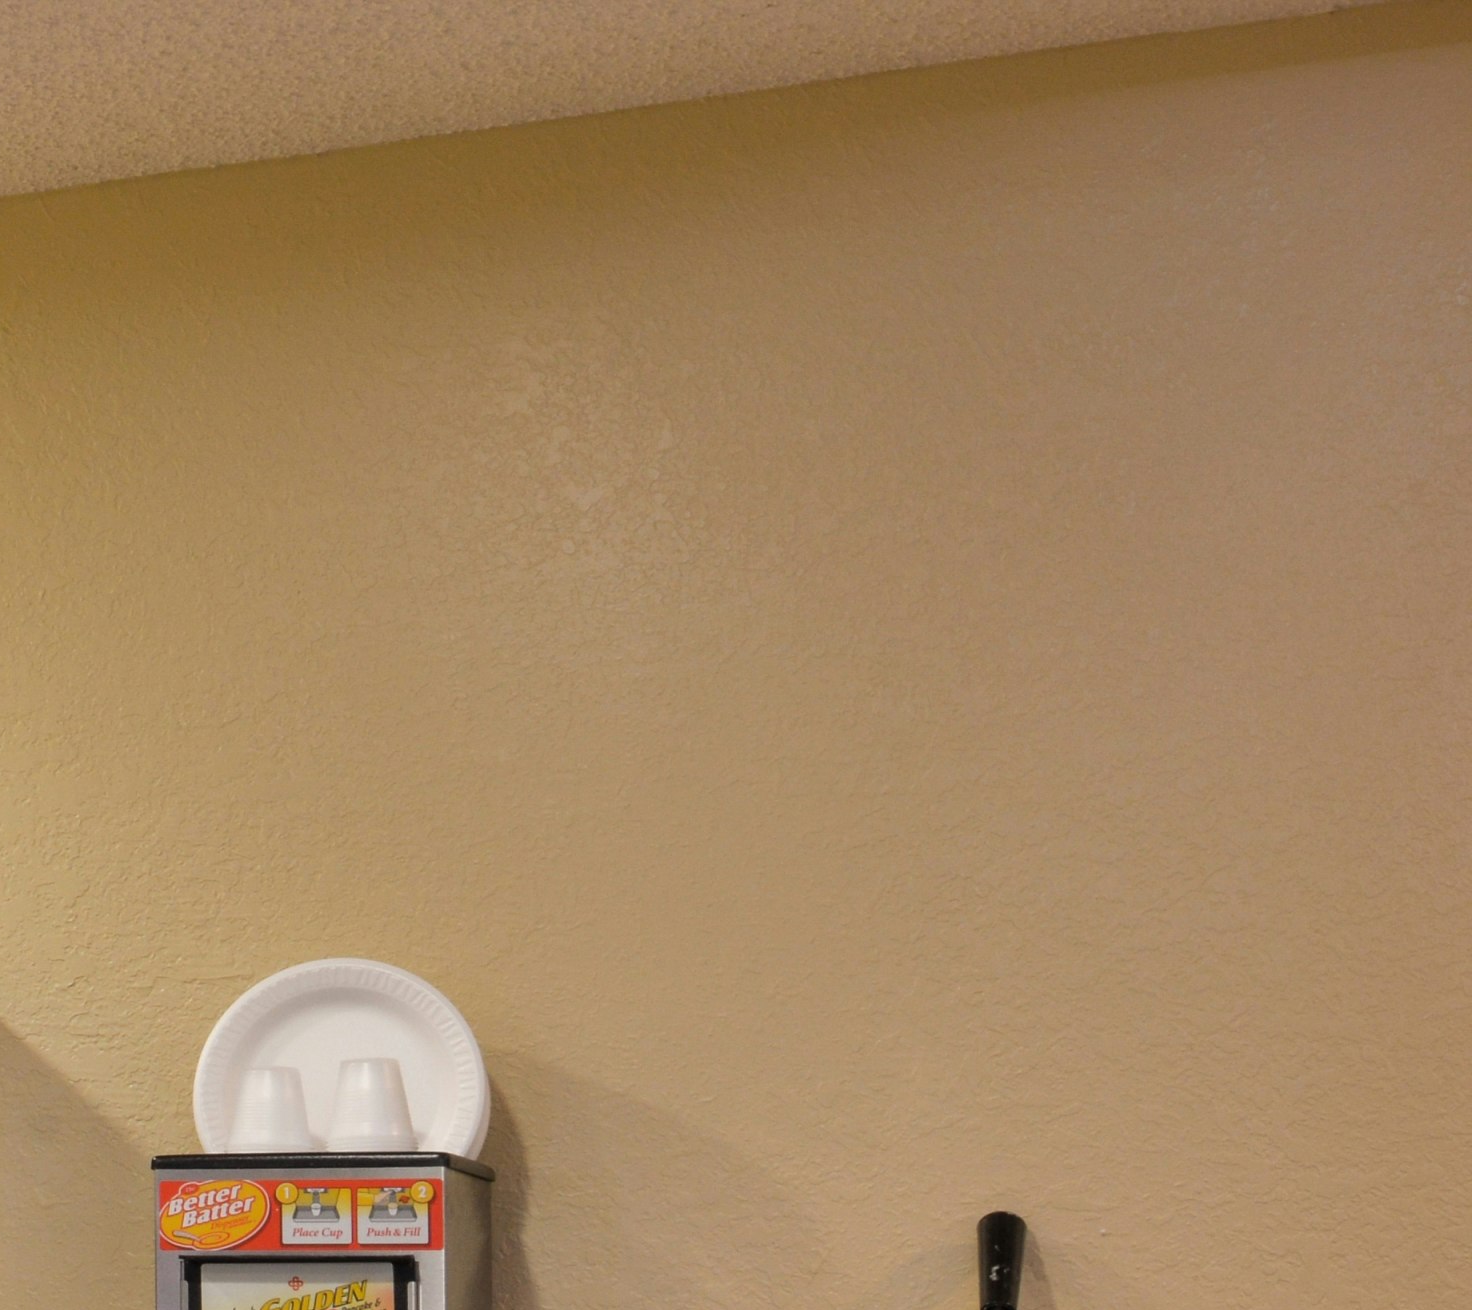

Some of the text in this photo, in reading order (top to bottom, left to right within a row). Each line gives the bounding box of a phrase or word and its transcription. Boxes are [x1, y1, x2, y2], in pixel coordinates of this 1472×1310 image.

[284, 1187, 291, 1199] 1
[418, 1186, 427, 1199] 2
[168, 1185, 241, 1216] Better
[182, 1197, 255, 1228] Batter
[292, 1227, 343, 1239] Place Cup
[367, 1227, 421, 1237] Push & Fill
